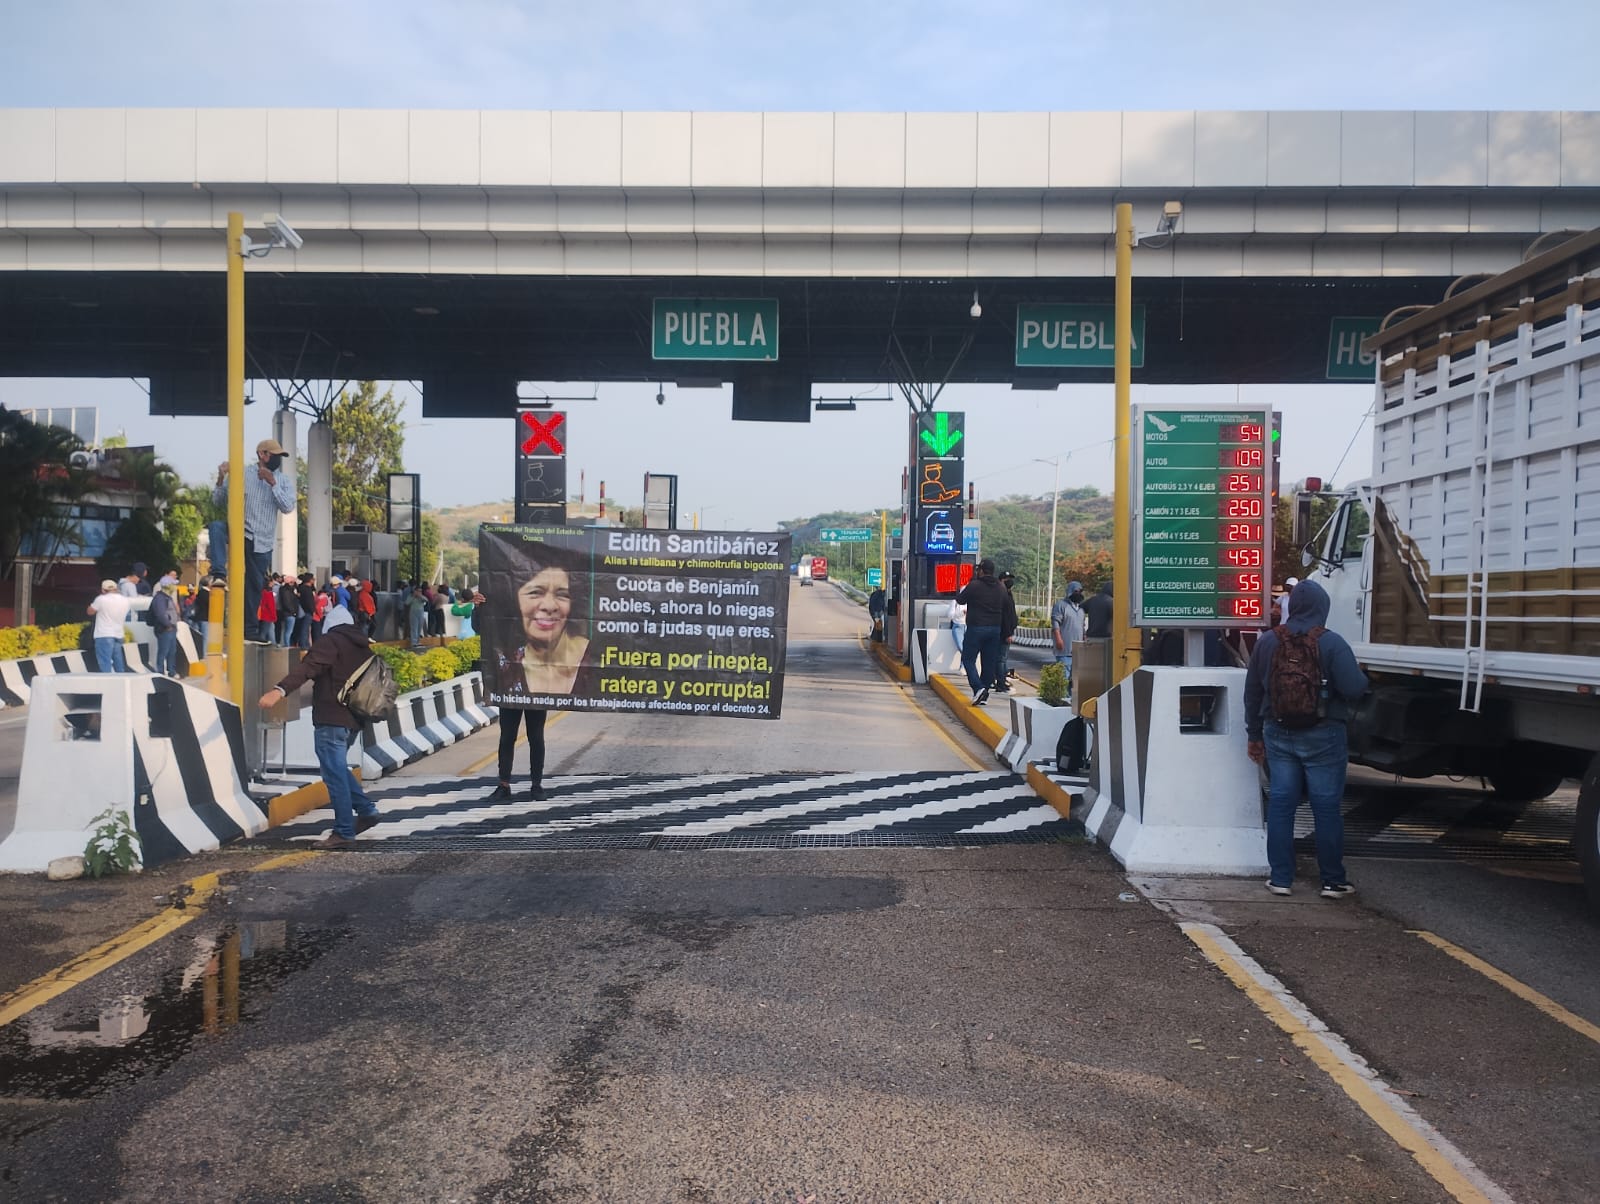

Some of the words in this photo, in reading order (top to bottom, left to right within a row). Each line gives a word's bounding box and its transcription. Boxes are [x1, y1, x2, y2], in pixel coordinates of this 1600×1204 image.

[665, 312, 767, 346] PUEBLA
[1145, 433, 1168, 441] MOTOS
[1240, 425, 1261, 441] 54
[1145, 458, 1168, 466] AUTOS
[1236, 450, 1261, 466] 109
[1229, 475, 1261, 491] 251
[1184, 507, 1200, 515] EJES
[1229, 499, 1261, 516] 250
[1184, 532, 1200, 540] EJES
[1229, 524, 1260, 540] 291
[608, 532, 660, 552] Edith
[667, 535, 779, 556] Santibáñez
[604, 555, 627, 565] Alias
[629, 556, 638, 565] la
[640, 557, 676, 568] talibana
[678, 559, 685, 569] y
[687, 559, 742, 570] chimoltrufia
[744, 560, 784, 571] bigotona
[1194, 557, 1208, 565] EJES
[1228, 550, 1260, 566] 453
[616, 576, 661, 592] Cuota
[666, 579, 684, 593] de
[688, 579, 759, 598] Benjamín
[1144, 581, 1156, 590] EJE
[1156, 581, 1192, 590] EXCEDENTE
[1192, 582, 1215, 590] LIGERO
[1239, 574, 1260, 591] 55
[599, 597, 656, 616] Robles,
[660, 600, 704, 615] ahora
[708, 602, 722, 615] lo
[726, 602, 774, 620] niegas
[1144, 606, 1156, 615] EJE
[1156, 606, 1192, 615] EXCEDENTE
[1192, 606, 1214, 615] CARGA
[1235, 599, 1260, 616] 125
[598, 620, 639, 633] como
[644, 620, 656, 634] la
[660, 621, 702, 638] judas
[706, 624, 734, 639] que
[738, 626, 774, 638] eres.
[600, 646, 662, 668] ¡Fuera
[668, 652, 703, 670] por
[708, 650, 774, 674] inepta,
[600, 676, 658, 694] ratera
[663, 680, 676, 700] y
[680, 680, 770, 702] corrupta!
[490, 692, 501, 702] No
[503, 694, 531, 704] hiciste
[533, 696, 554, 705] nada
[556, 697, 572, 708] por
[574, 696, 588, 706] los
[590, 698, 646, 710] trabajadores
[648, 700, 692, 711] afectados
[694, 702, 710, 713] por
[712, 702, 720, 712] el
[722, 703, 756, 714] decreto
[757, 704, 772, 714] 24.
